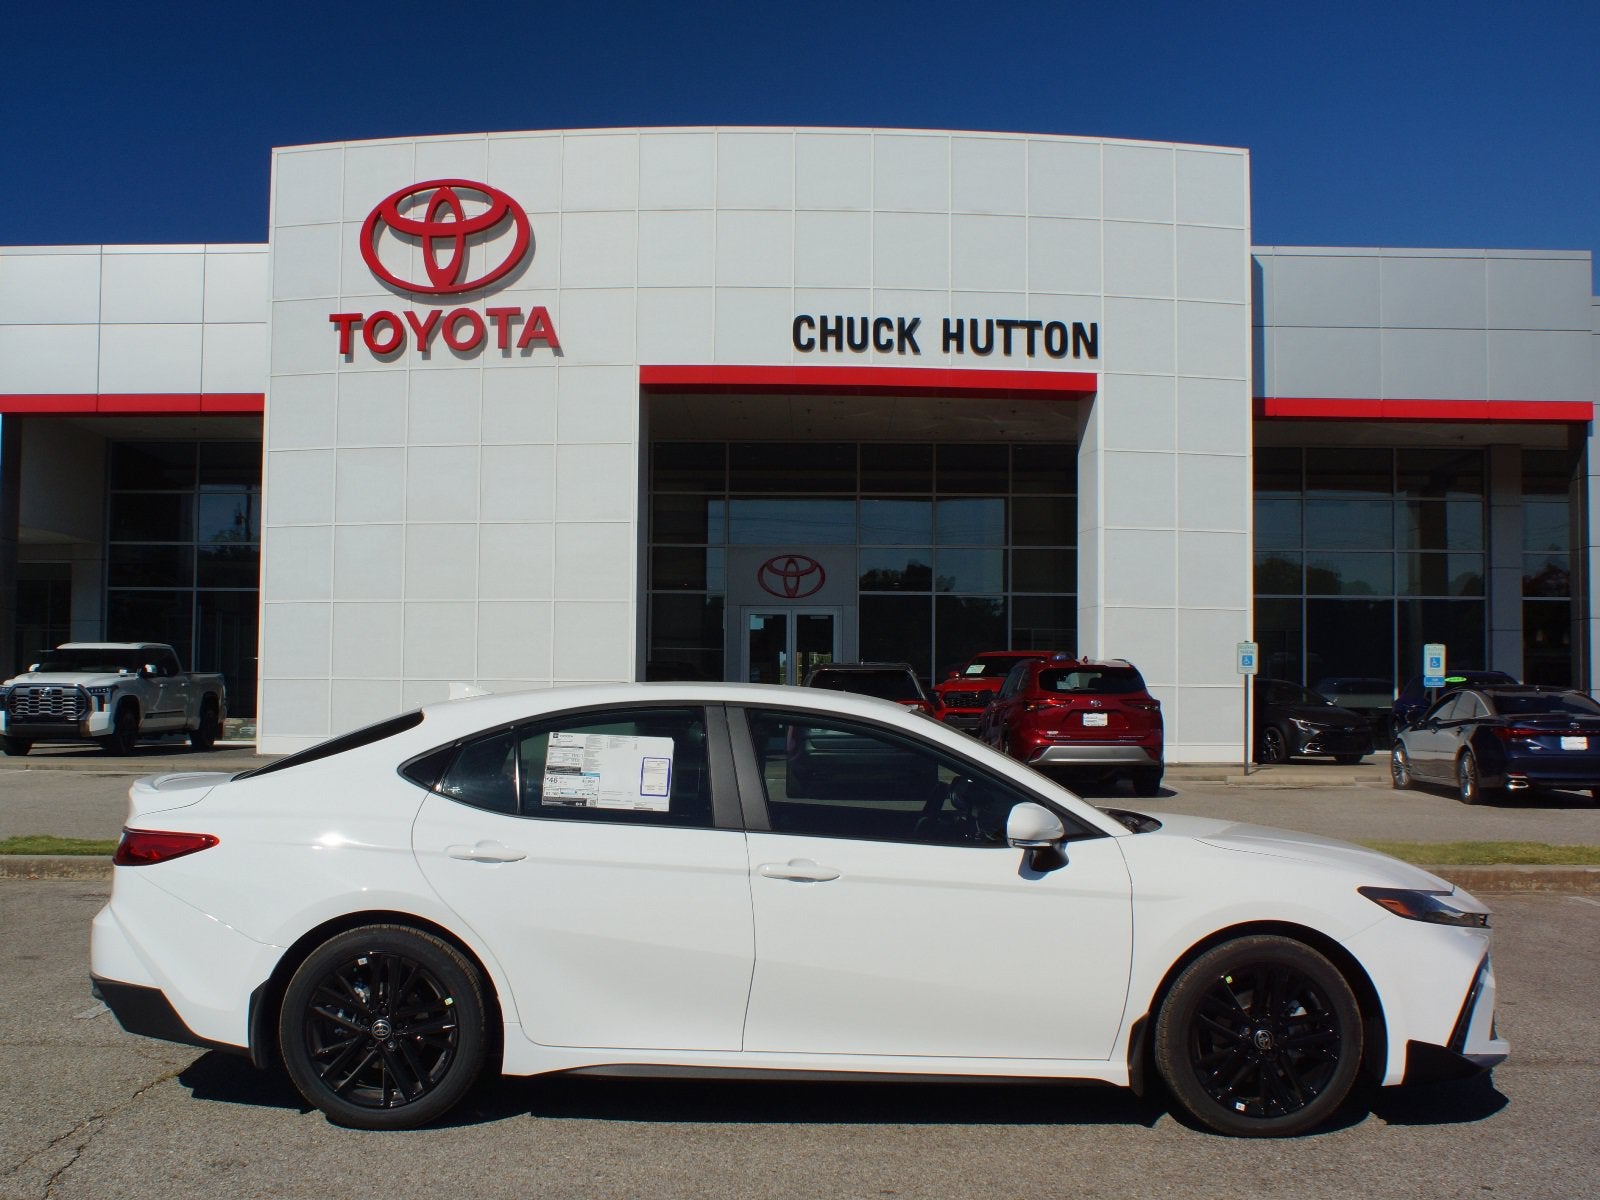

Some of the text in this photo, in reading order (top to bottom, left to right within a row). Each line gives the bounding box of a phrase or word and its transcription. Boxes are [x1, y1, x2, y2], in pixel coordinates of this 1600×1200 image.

[329, 306, 561, 355] TOYOTA
[792, 314, 1099, 359] CHUCK HUTTON
